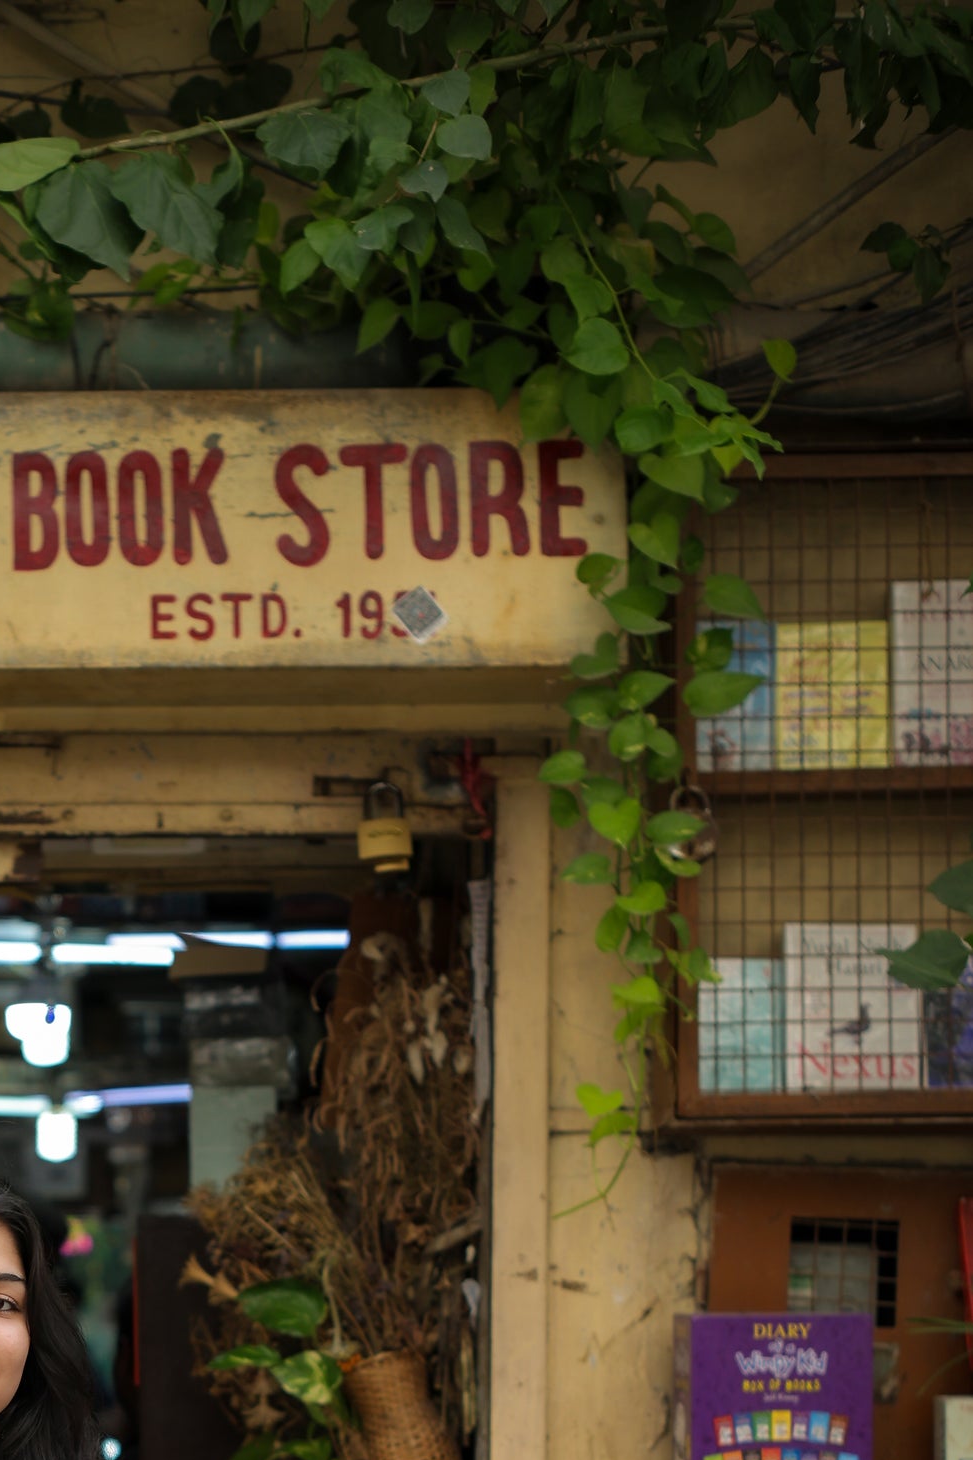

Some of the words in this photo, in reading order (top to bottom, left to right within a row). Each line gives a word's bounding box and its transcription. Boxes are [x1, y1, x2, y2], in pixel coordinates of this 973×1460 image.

[12, 446, 229, 571] BOOK
[274, 439, 589, 566] STORE
[150, 592, 303, 640] ESTD.
[335, 590, 436, 639] 19
[797, 1041, 916, 1079] Nexus
[753, 1322, 811, 1340] DIARY
[735, 1350, 796, 1378] Wimpy
[796, 1347, 828, 1375] Kid
[785, 1379, 821, 1392] BOOKS
